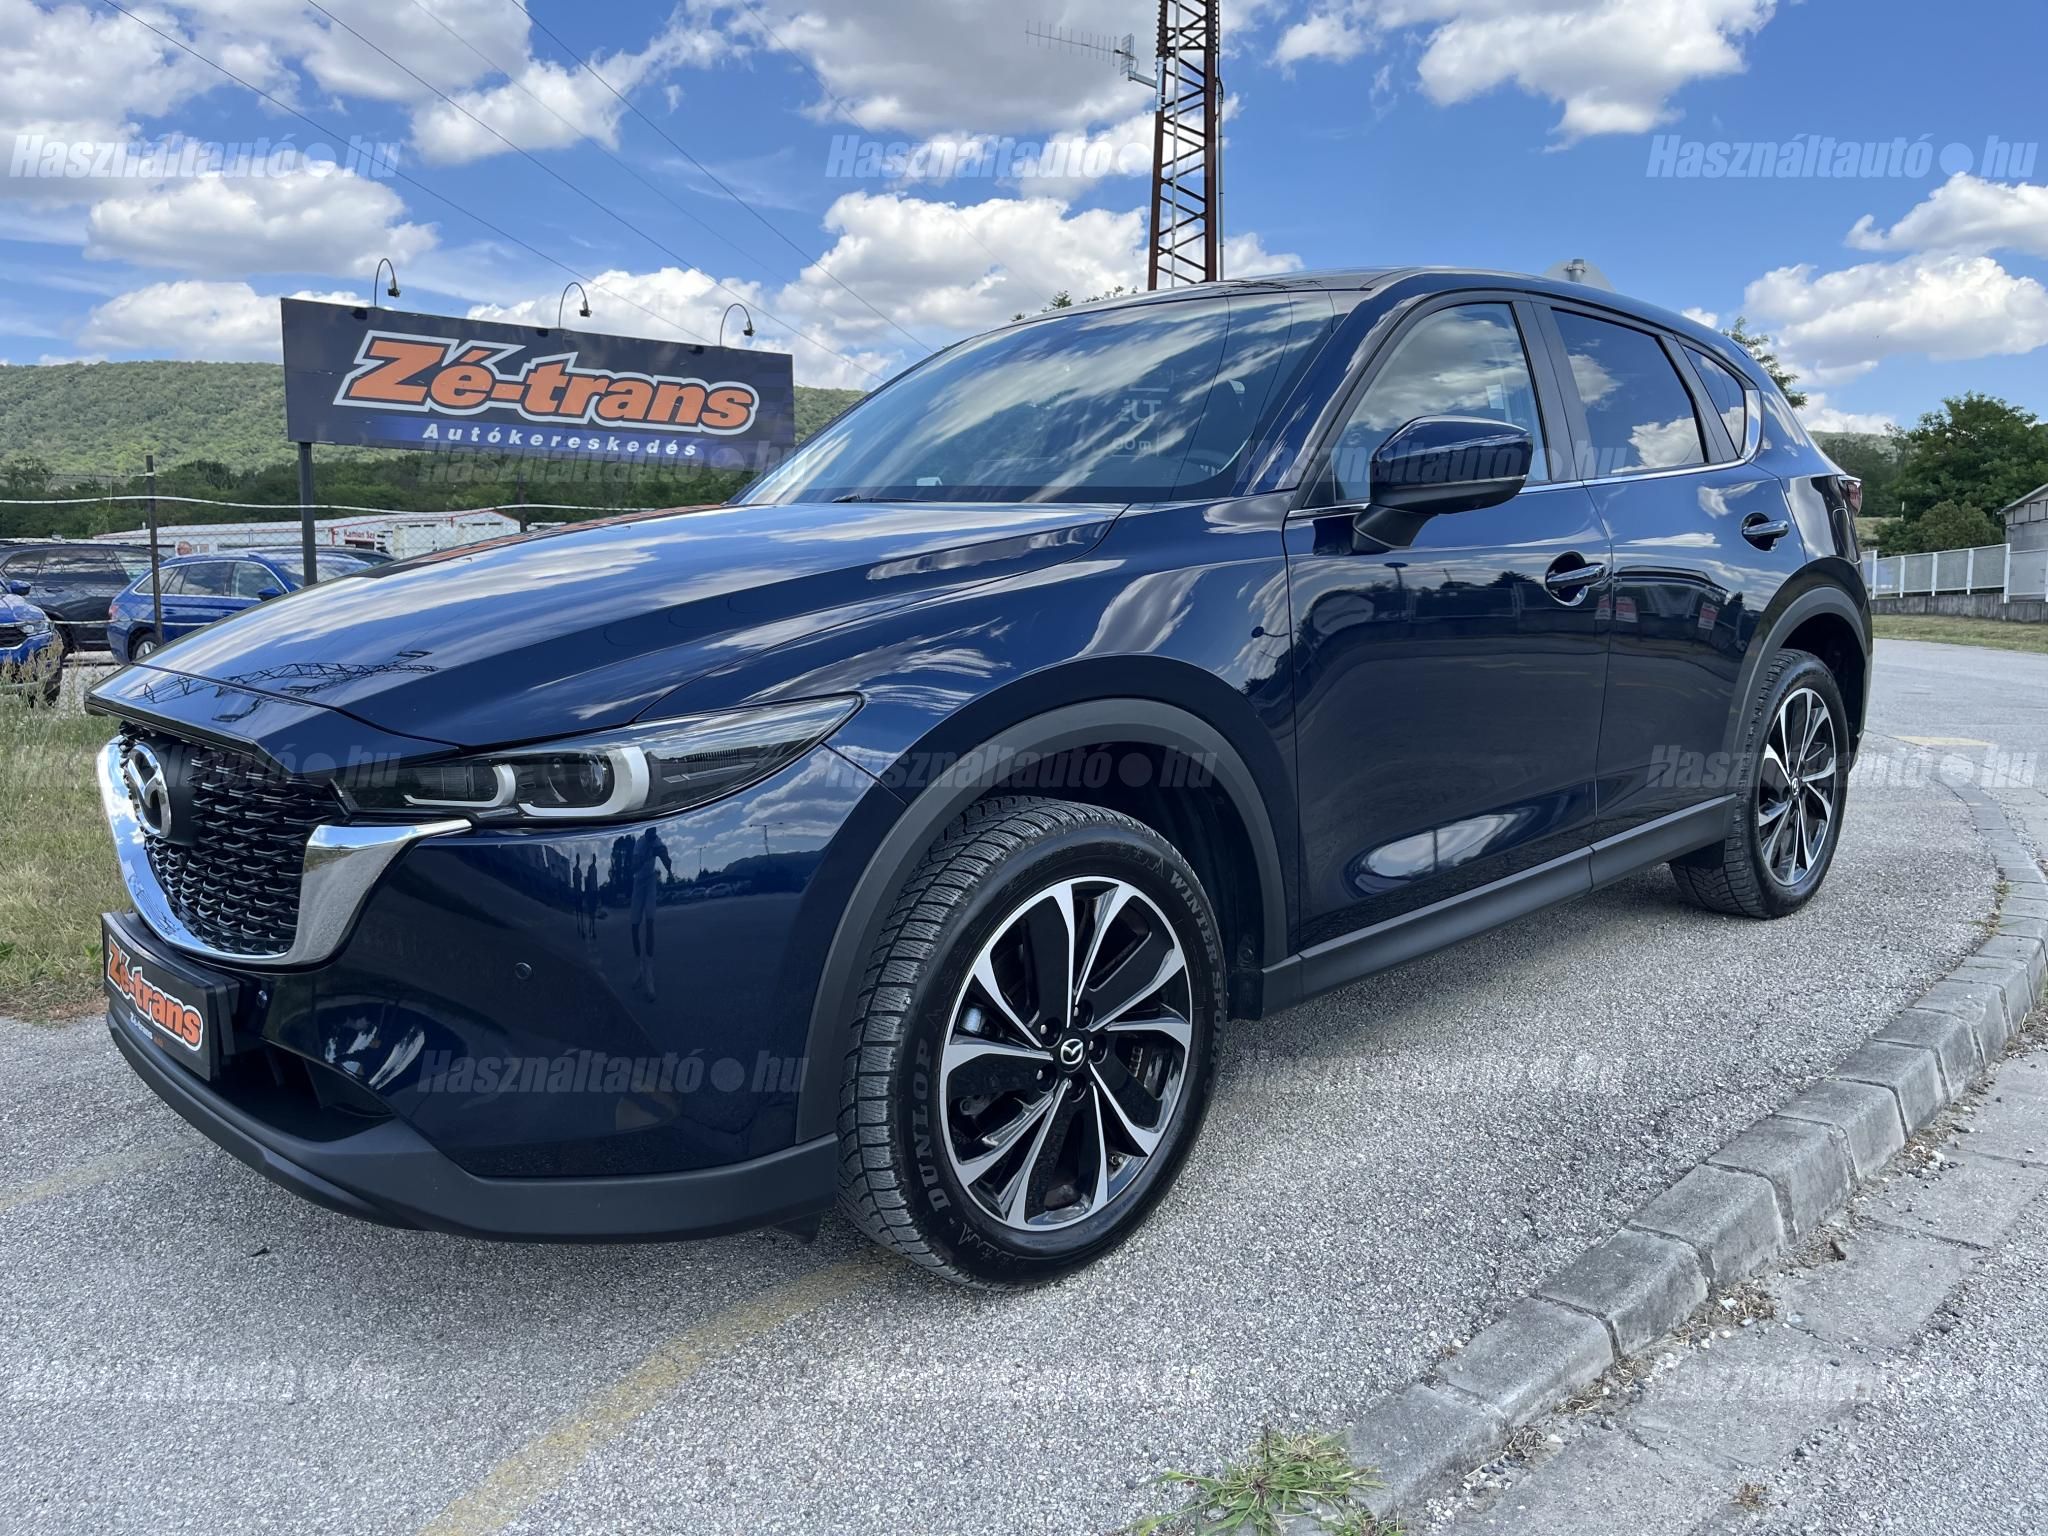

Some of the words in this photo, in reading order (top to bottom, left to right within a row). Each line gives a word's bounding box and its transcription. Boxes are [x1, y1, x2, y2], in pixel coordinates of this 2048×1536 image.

[336, 331, 757, 433] Zé-trans
[422, 423, 698, 457] Autókereskedés
[1169, 869, 1217, 964] WINTER
[912, 1037, 951, 1212] DUNLOP
